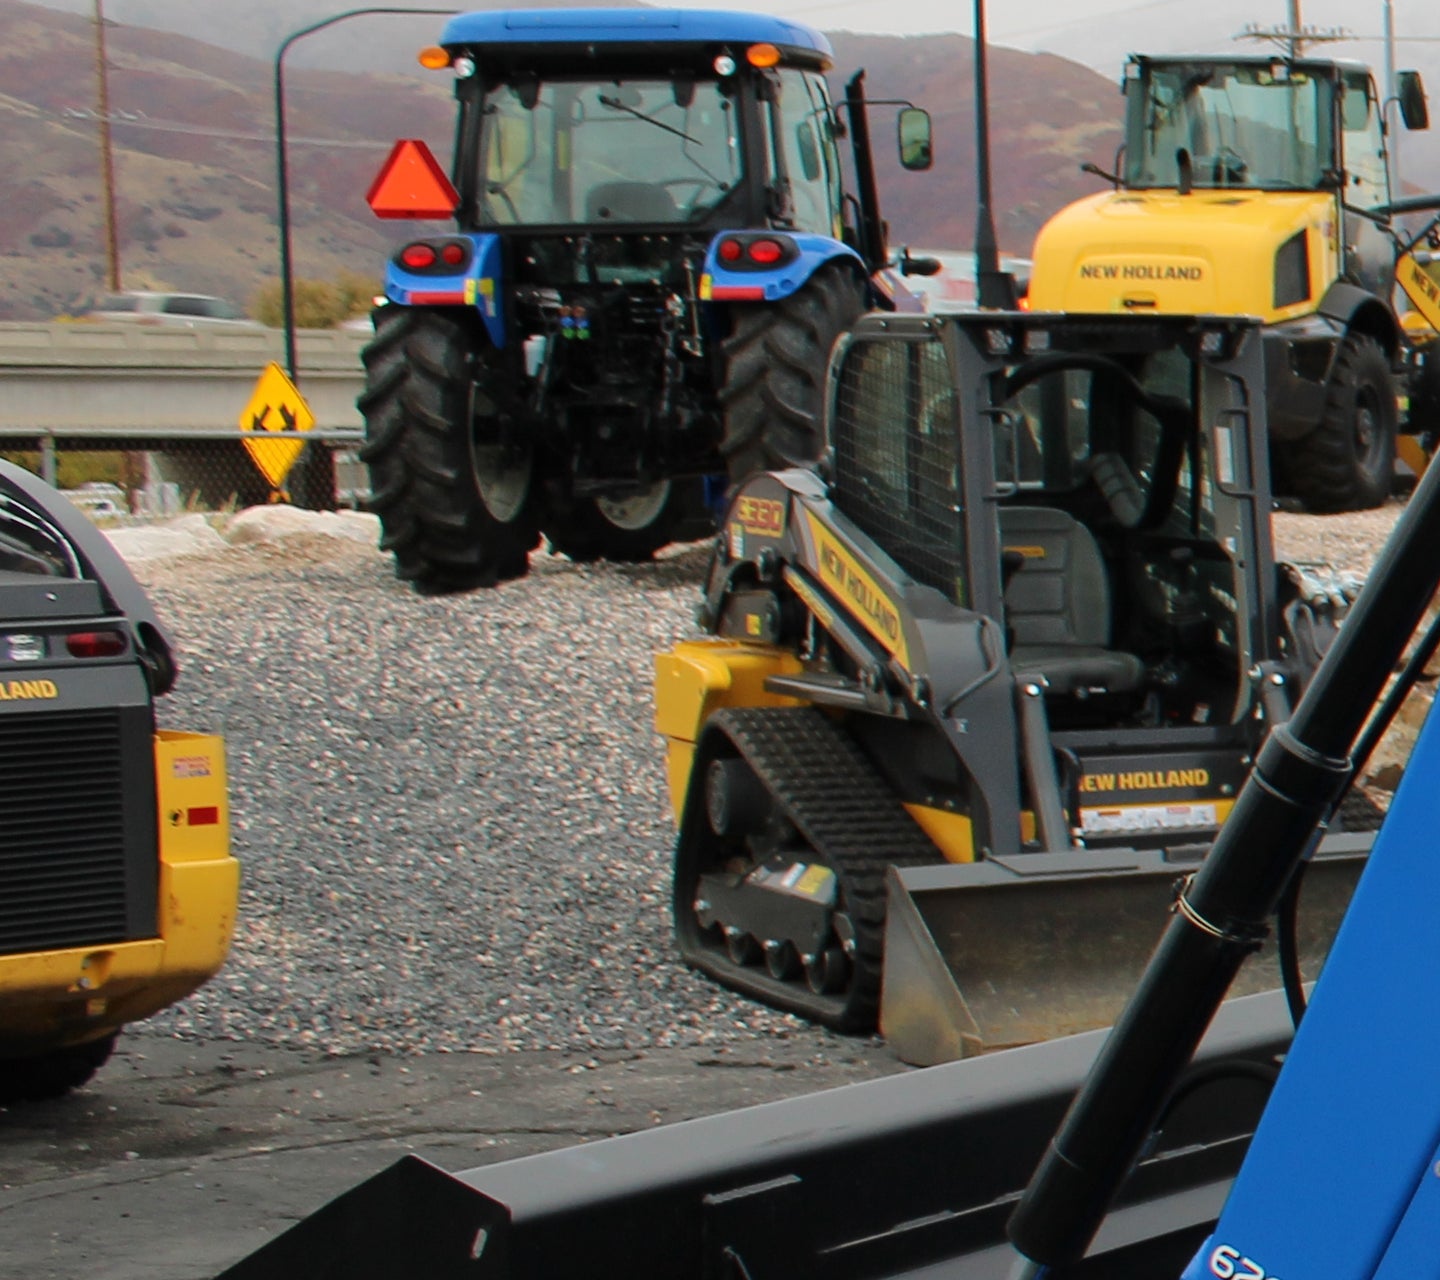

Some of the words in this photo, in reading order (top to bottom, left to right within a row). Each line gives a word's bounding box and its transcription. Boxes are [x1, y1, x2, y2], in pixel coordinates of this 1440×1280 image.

[1080, 265, 1119, 279] NEW
[1122, 266, 1202, 281] HOLLAND
[1118, 769, 1209, 789] HOLLAND
